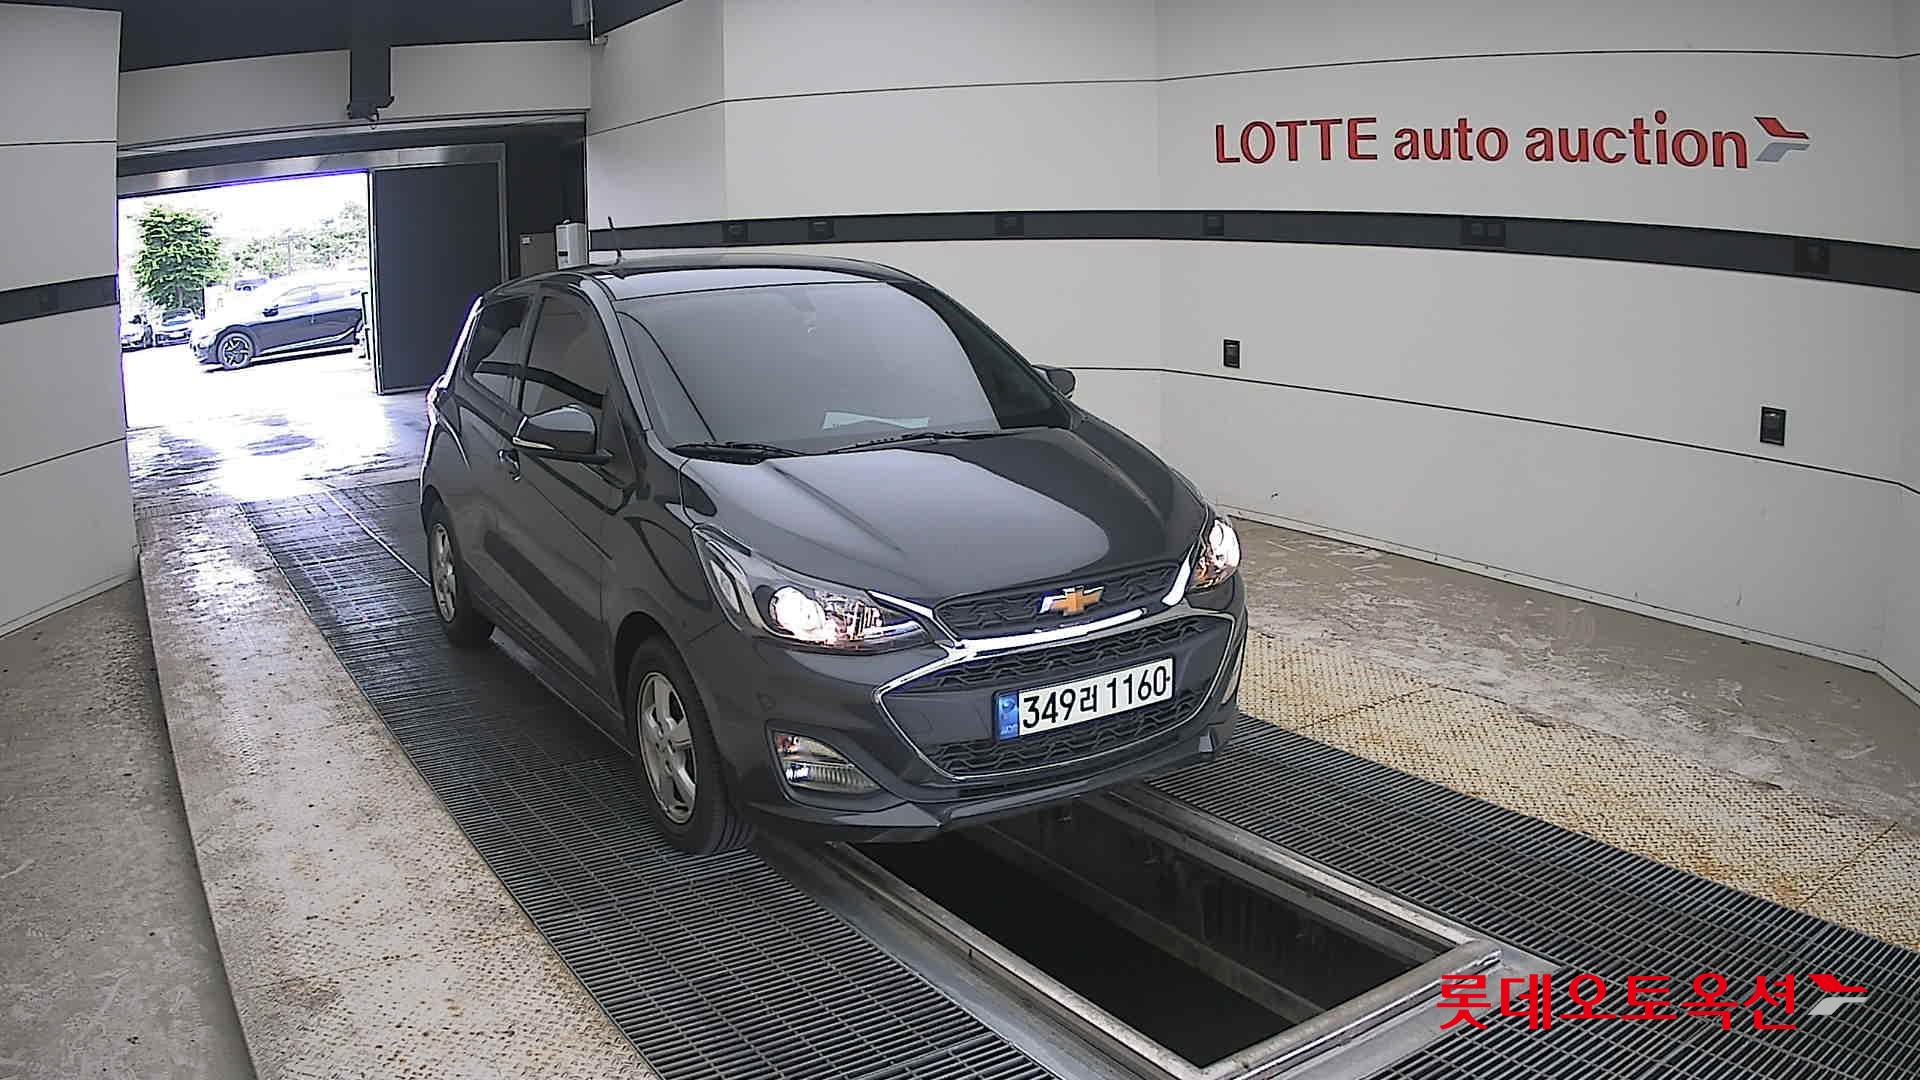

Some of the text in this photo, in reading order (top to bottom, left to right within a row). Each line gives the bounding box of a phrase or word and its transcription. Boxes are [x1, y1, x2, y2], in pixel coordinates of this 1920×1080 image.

[1215, 110, 1748, 169] LOTTE auto auction
[1022, 665, 1168, 729] 349러 1160
